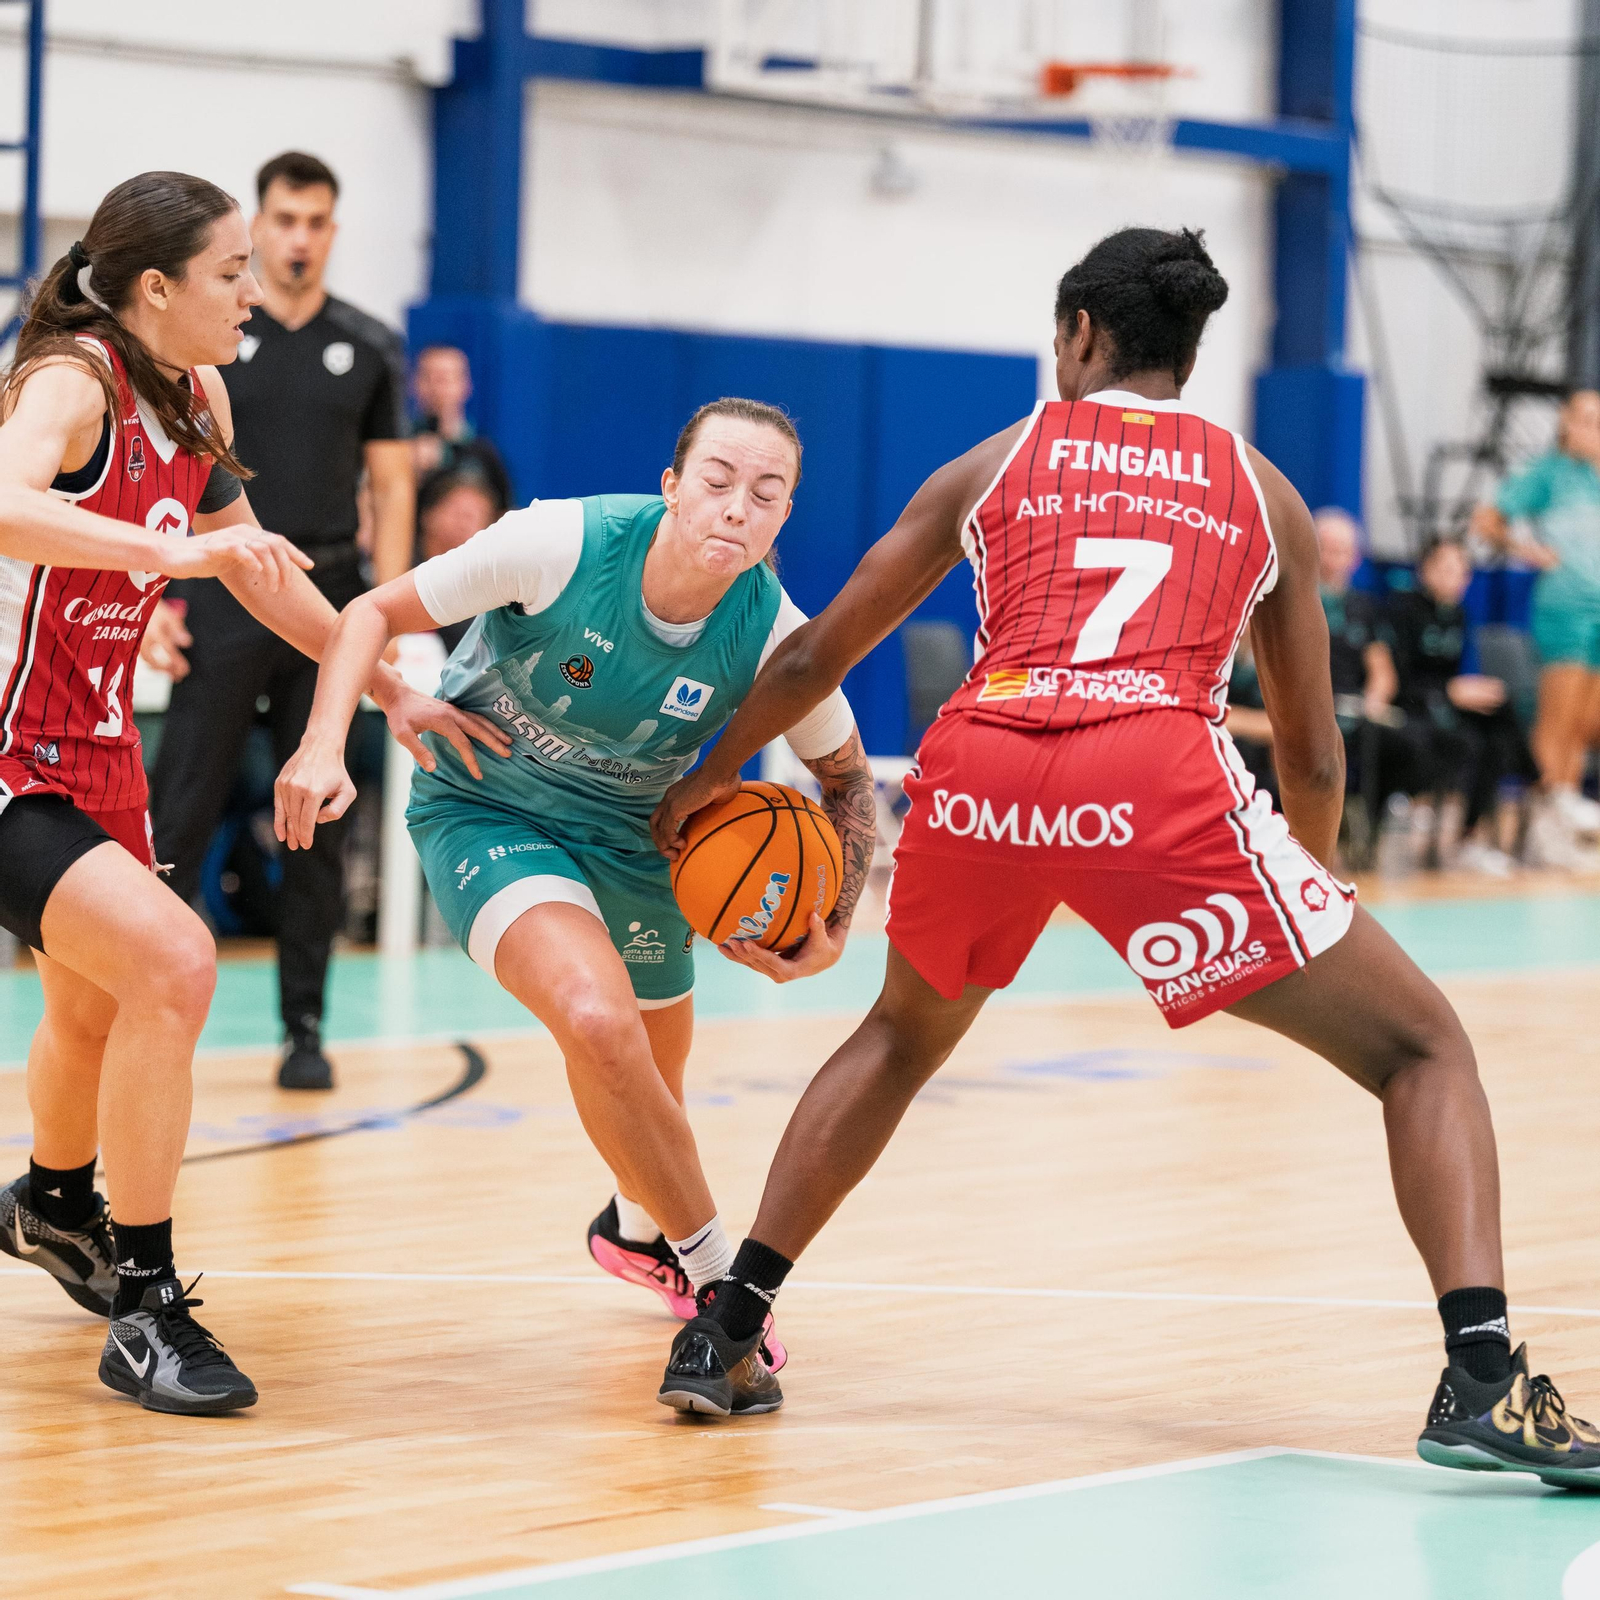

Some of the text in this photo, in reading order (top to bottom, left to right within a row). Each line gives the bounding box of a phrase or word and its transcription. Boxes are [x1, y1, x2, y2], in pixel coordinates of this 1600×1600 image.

[1048, 438, 1211, 487] FINGALL
[1015, 490, 1243, 545] AIR HORIZONT
[1071, 537, 1174, 663] 7
[583, 627, 615, 654] vive
[560, 664, 591, 688] ESTEPONA
[928, 789, 1134, 847] SOMMOS
[457, 865, 480, 891] vive
[1148, 940, 1267, 1005] YANGUAS
